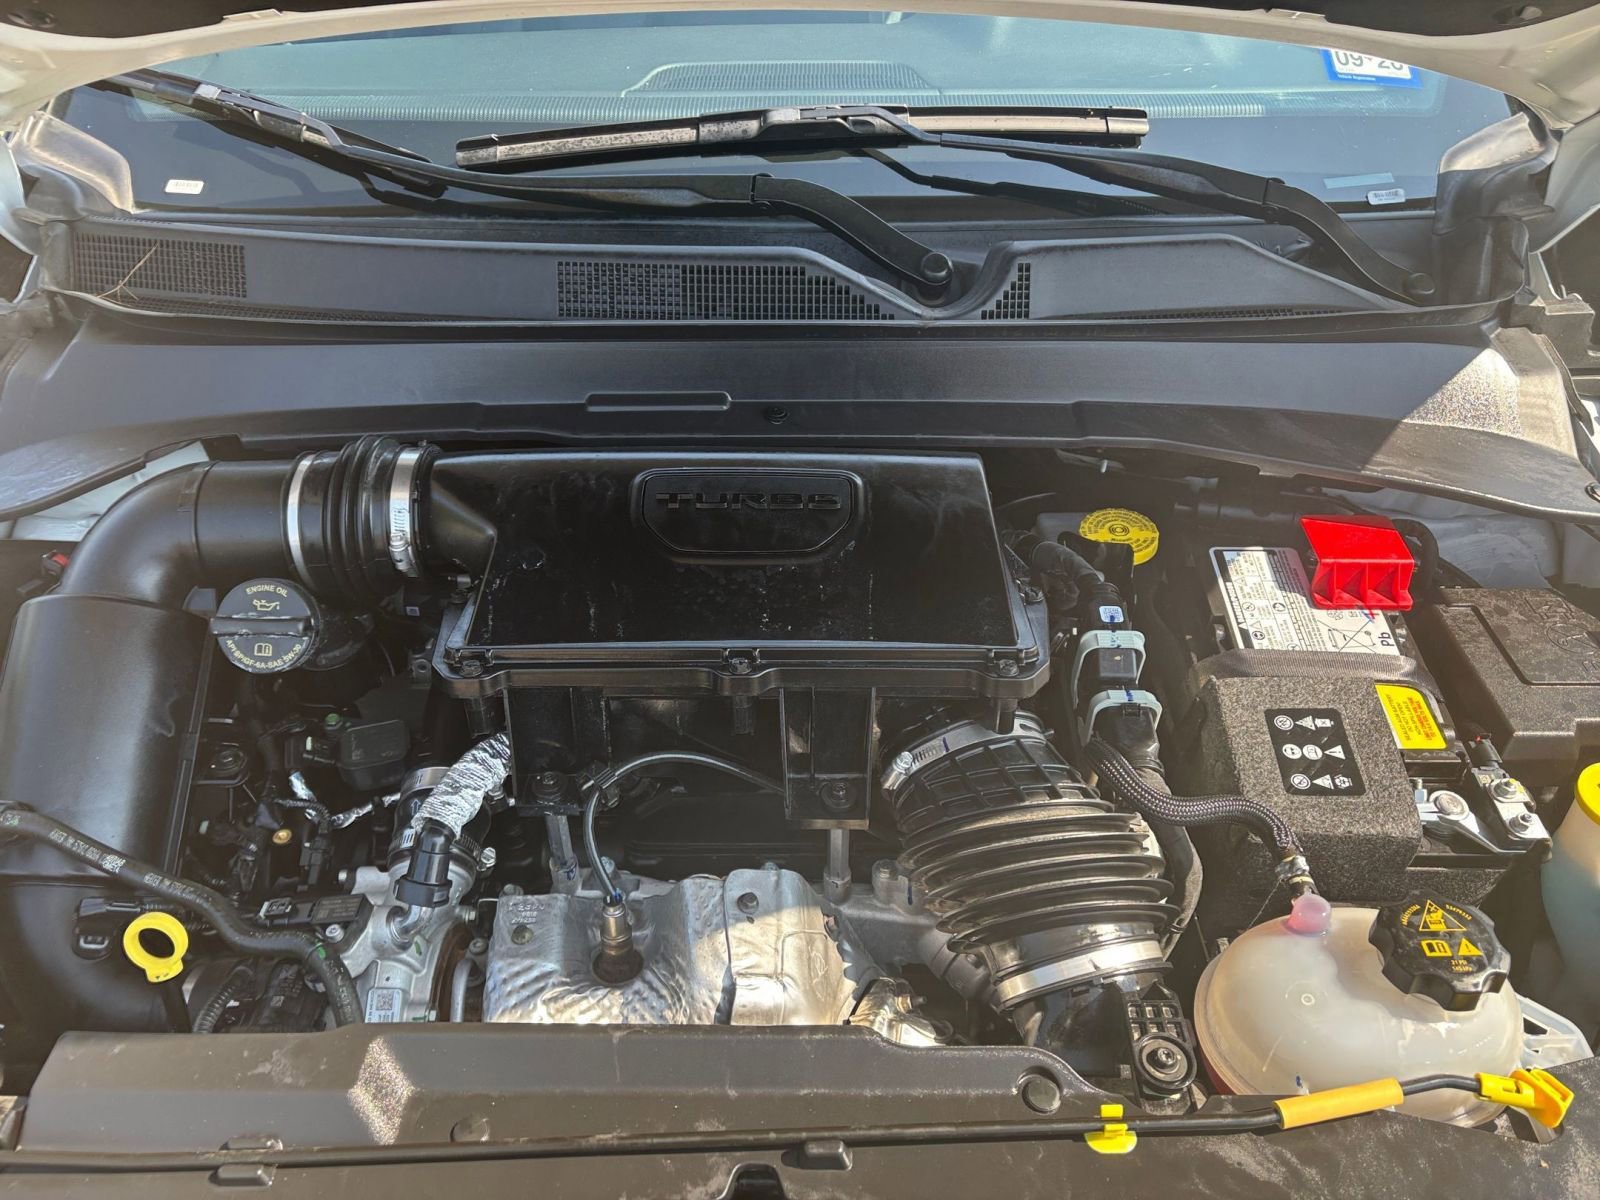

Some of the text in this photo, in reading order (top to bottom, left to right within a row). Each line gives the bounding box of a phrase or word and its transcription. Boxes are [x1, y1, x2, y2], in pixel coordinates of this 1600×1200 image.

[655, 492, 841, 510] TURBO
[246, 584, 288, 598] ENGINE OIL
[1378, 632, 1394, 646] Pb
